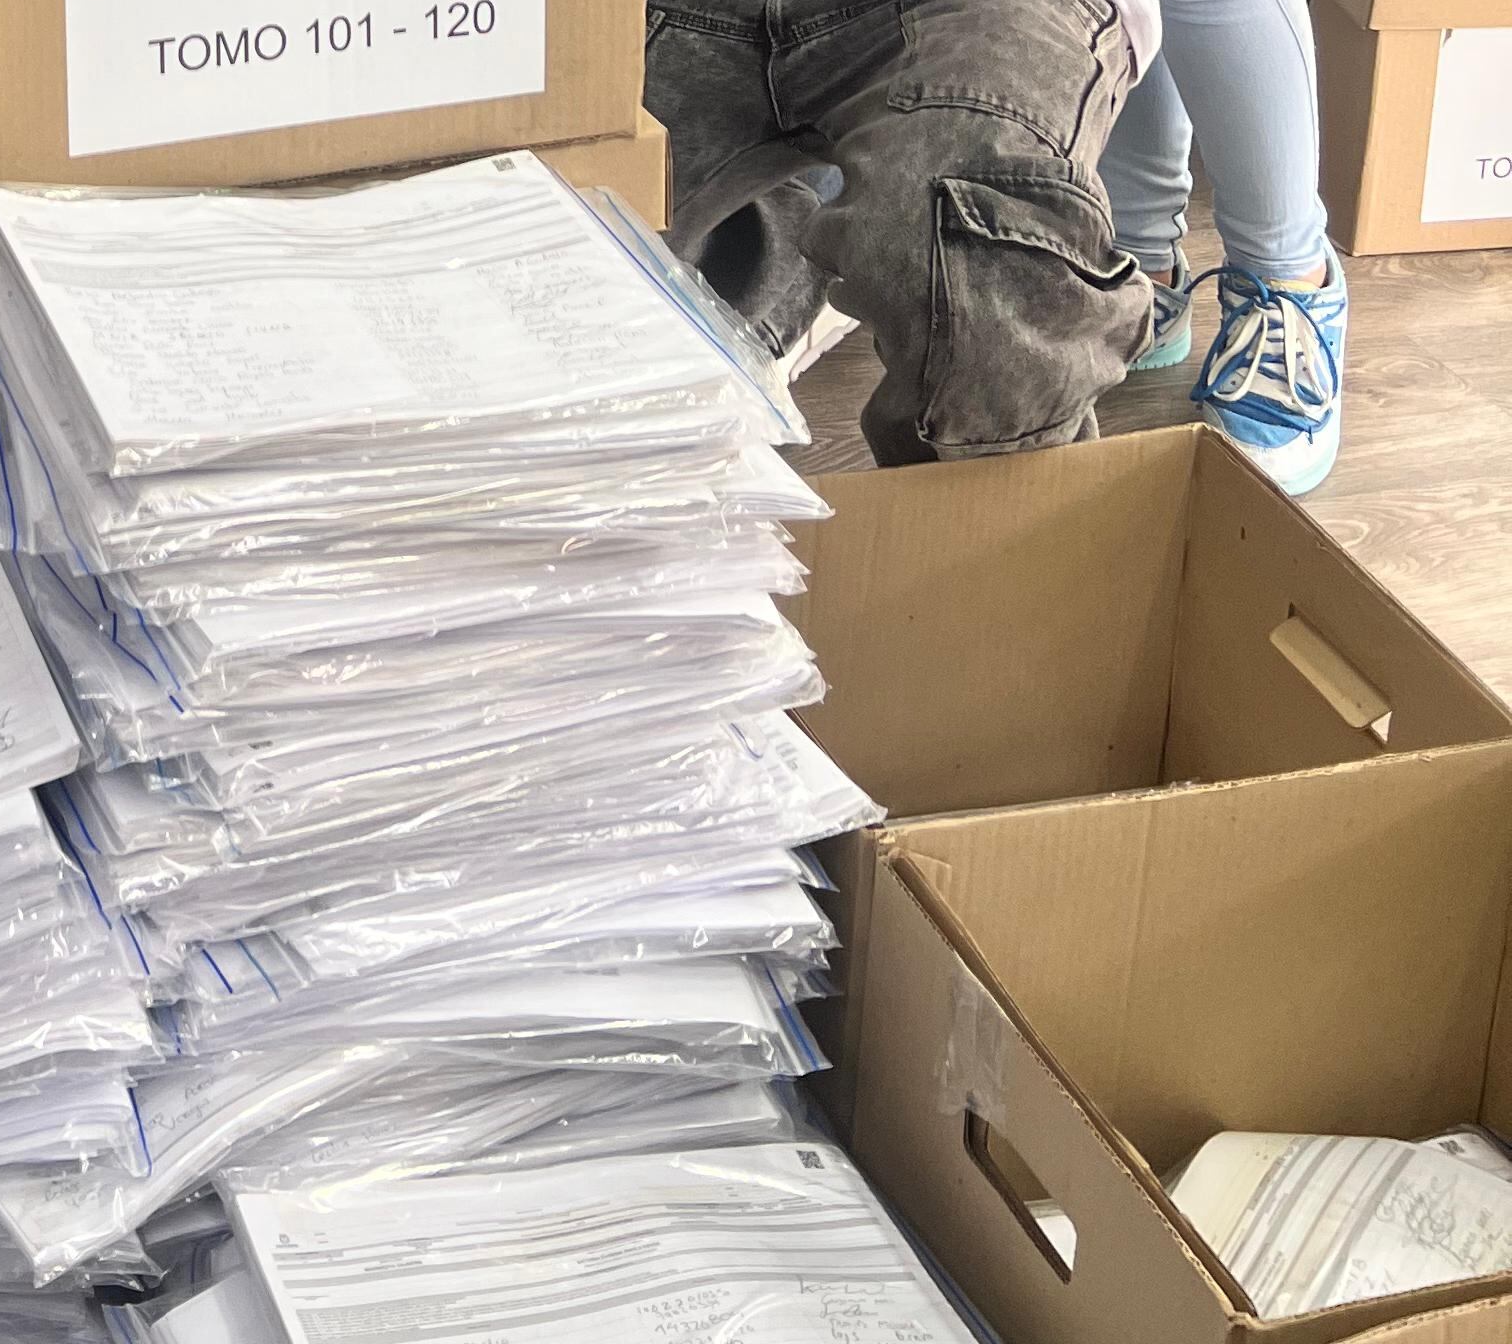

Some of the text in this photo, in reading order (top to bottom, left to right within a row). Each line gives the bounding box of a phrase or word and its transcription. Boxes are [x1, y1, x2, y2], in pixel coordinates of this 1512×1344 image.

[148, 23, 287, 75] TOMO
[305, 11, 372, 54] 101
[424, 0, 496, 40] 120
